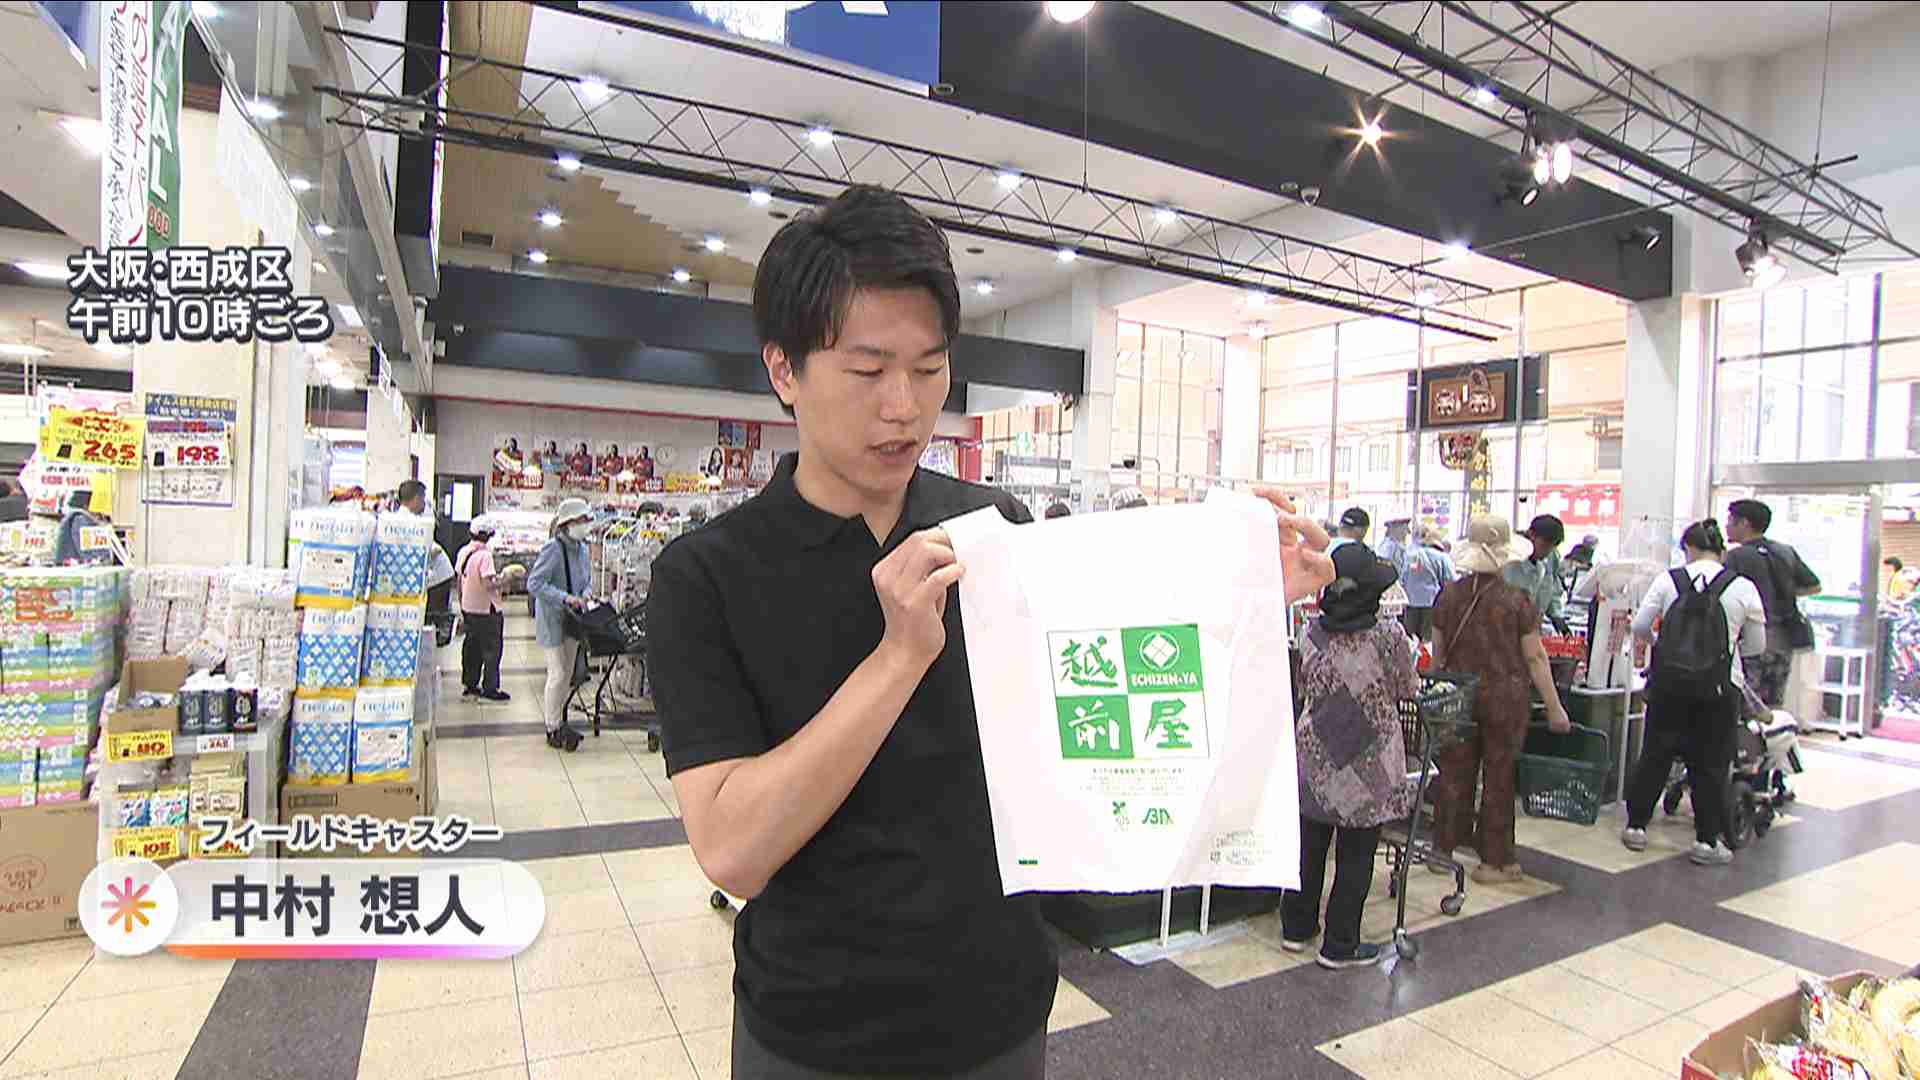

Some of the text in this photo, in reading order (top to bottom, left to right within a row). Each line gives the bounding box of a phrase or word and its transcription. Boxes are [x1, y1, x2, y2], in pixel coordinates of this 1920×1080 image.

[82, 439, 138, 461] 265
[176, 445, 220, 462] 198
[1059, 635, 1120, 689] 越
[1068, 697, 1193, 753] 前 屋
